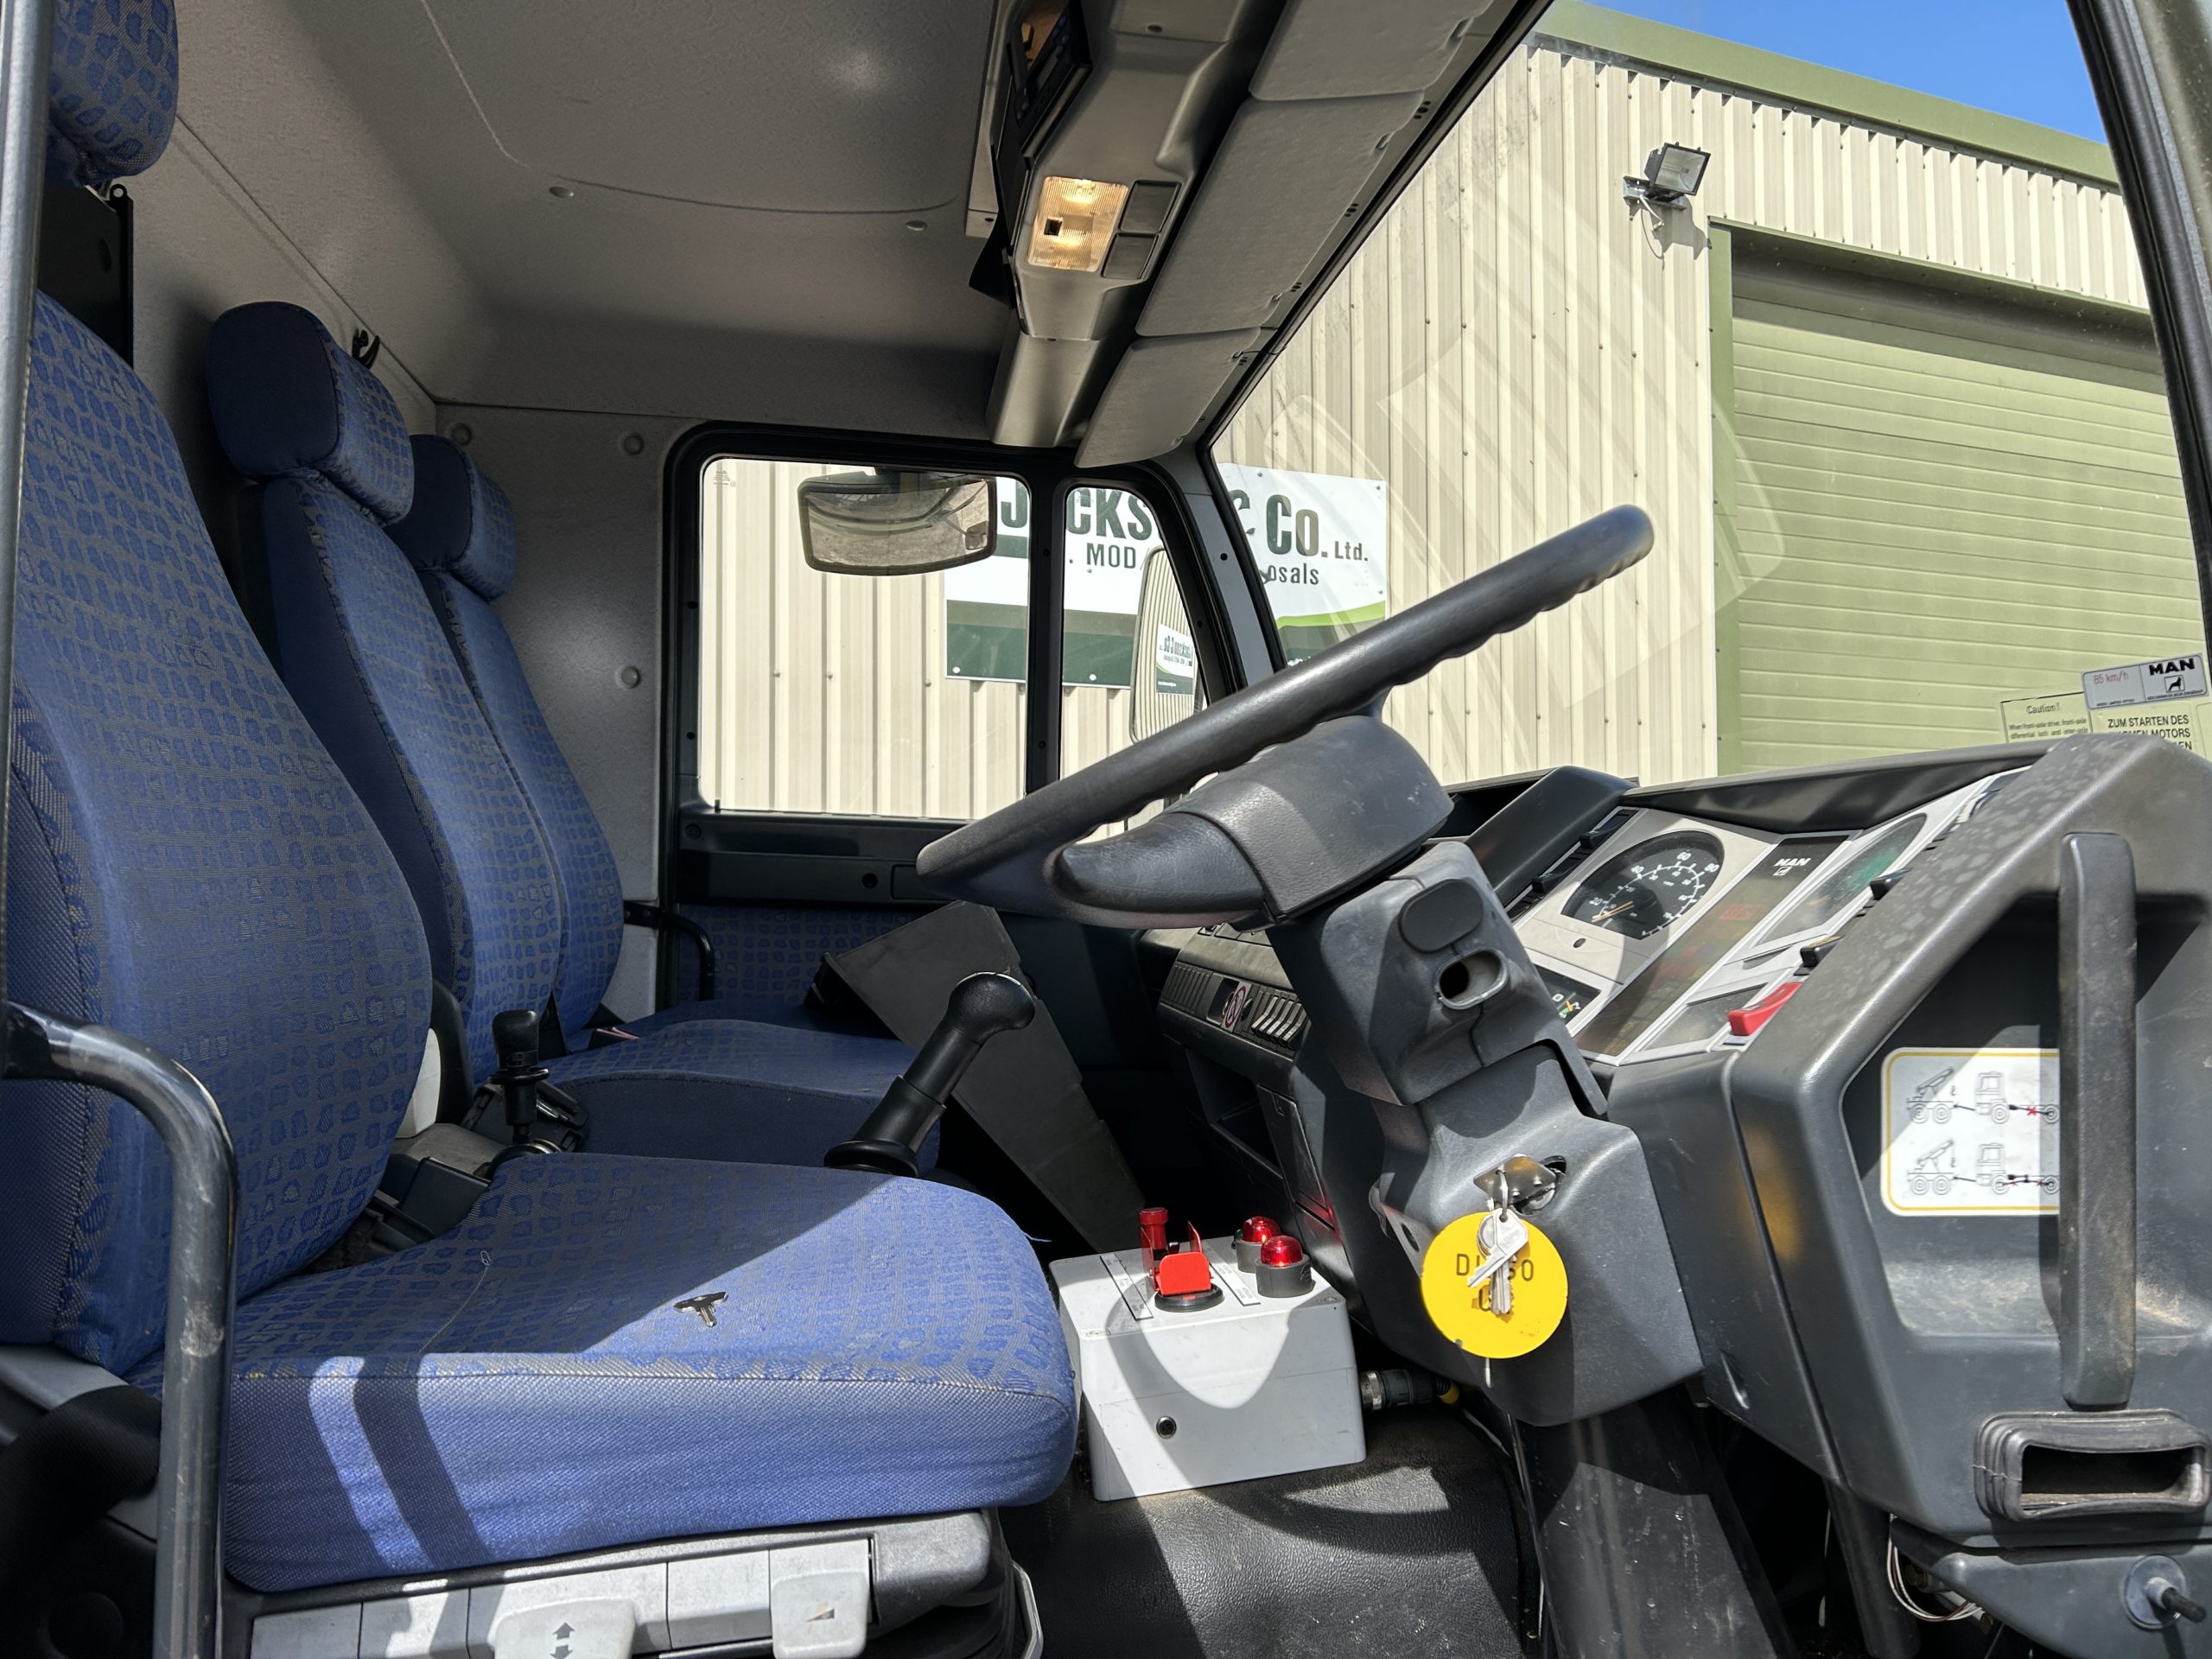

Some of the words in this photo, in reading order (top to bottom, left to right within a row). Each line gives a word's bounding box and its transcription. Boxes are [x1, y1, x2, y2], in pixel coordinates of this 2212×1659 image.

[1334, 540, 1369, 562] Ltd.
[1086, 542, 1137, 569] MOD
[1268, 562, 1320, 586] osals
[2148, 658, 2196, 676] MAN
[2107, 670, 2130, 683] km/h
[2108, 718, 2127, 728] ZUM
[2128, 715, 2170, 728] STARTEN
[2171, 714, 2190, 725] DES
[1677, 851, 1692, 861] 60
[1774, 857, 1812, 867] MAN
[1705, 862, 1719, 873] 80
[1590, 897, 1603, 906] 20
